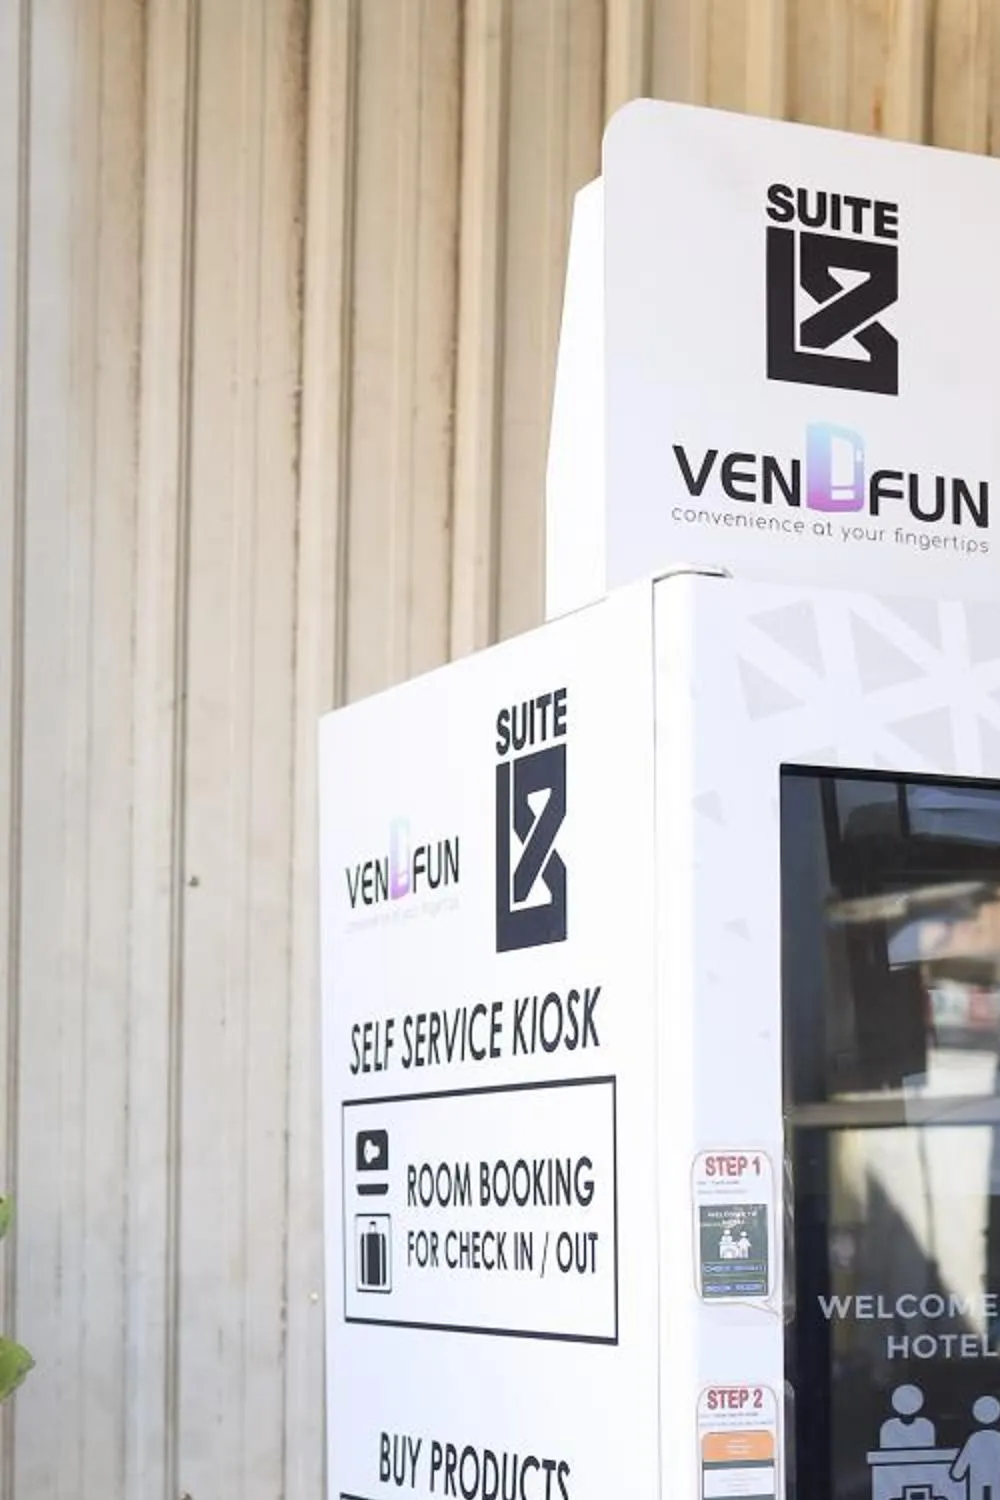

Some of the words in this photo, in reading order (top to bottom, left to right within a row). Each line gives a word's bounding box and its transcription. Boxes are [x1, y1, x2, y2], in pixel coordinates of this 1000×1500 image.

[766, 183, 898, 239] SUITE
[671, 505, 805, 534] convenience
[812, 519, 833, 537] at
[841, 523, 886, 544] your
[894, 527, 989, 555] fingertips
[496, 688, 567, 756] SUITE
[350, 1018, 395, 1075] SELF
[401, 1001, 503, 1070] SERVICE
[511, 986, 602, 1056] KIOSK
[407, 1160, 472, 1208] ROOM
[479, 1156, 596, 1208] BOOKING
[706, 1156, 748, 1176] STEP
[753, 1156, 761, 1175] 1
[407, 1230, 439, 1268] FOR
[445, 1230, 508, 1271] CHECK
[513, 1231, 533, 1272] IN
[540, 1231, 550, 1278] /
[556, 1231, 598, 1274] OUT
[817, 1293, 998, 1320] WELCOME
[887, 1334, 1000, 1359] HOTEL
[707, 1389, 749, 1410] STEP
[754, 1389, 762, 1408] 2
[379, 1431, 423, 1490] BUY
